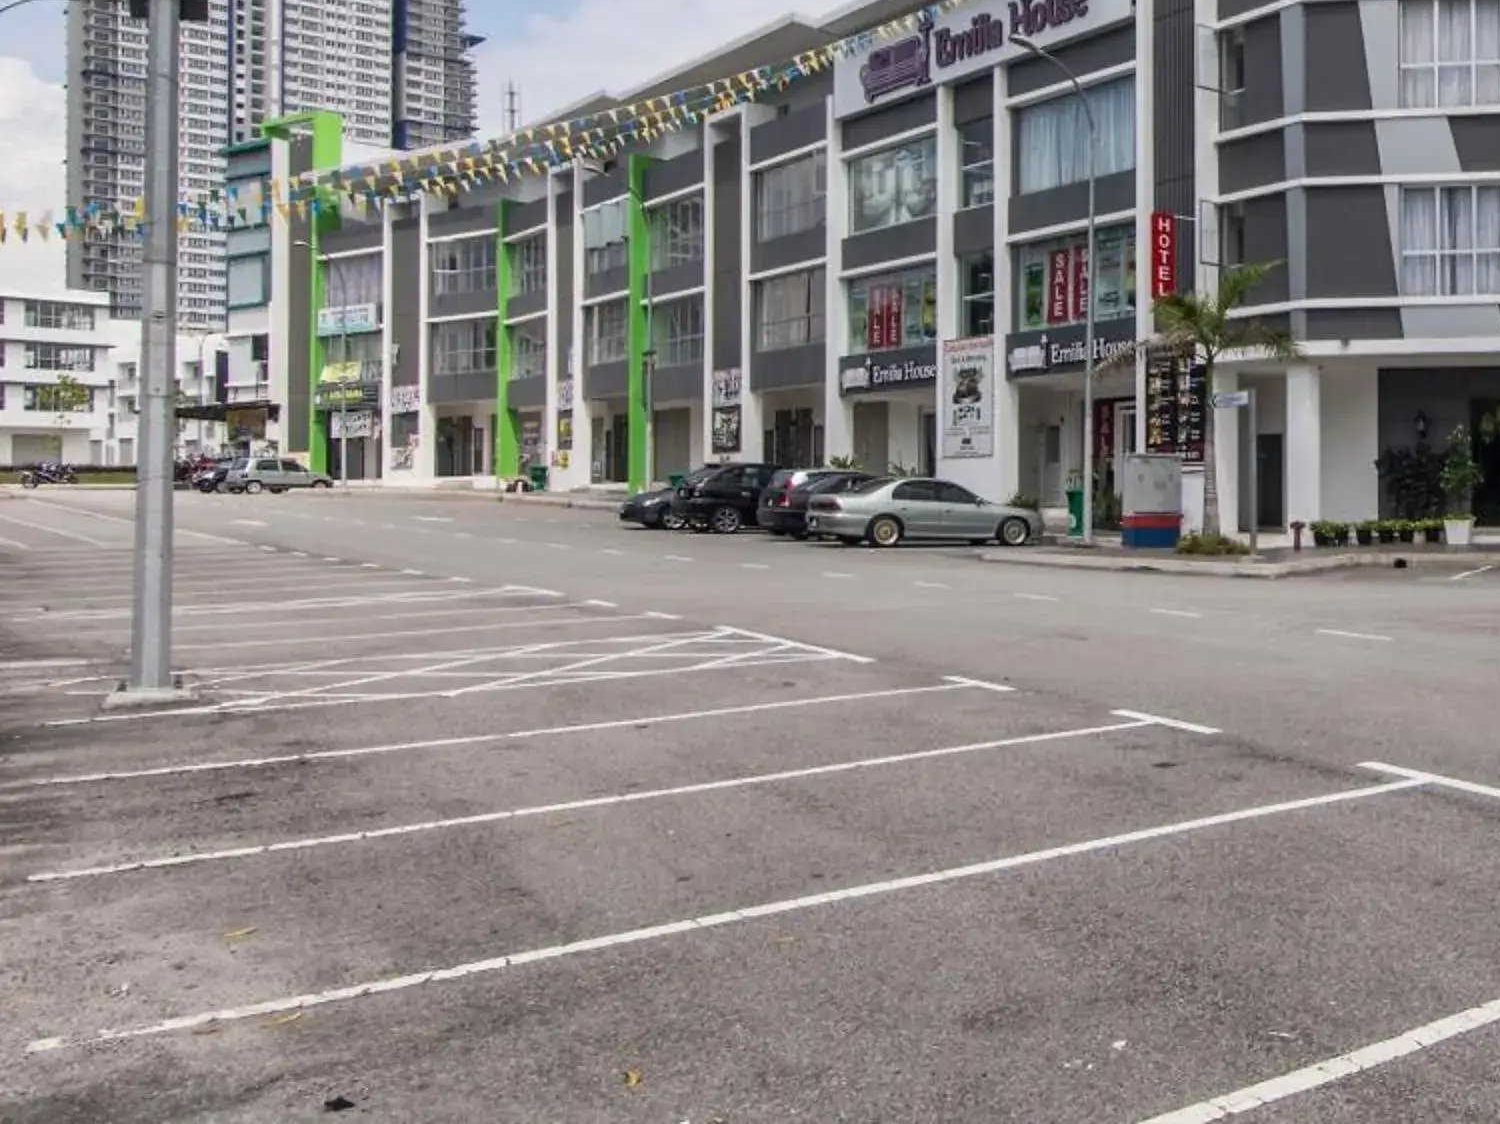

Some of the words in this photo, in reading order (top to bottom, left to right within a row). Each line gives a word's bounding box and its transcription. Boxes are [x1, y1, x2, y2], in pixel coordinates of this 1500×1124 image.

[933, 13, 1003, 68] Emilia
[1158, 216, 1171, 297] HOTEL
[1054, 252, 1065, 317] SALE
[904, 360, 940, 380] House
[1093, 337, 1135, 361] House
